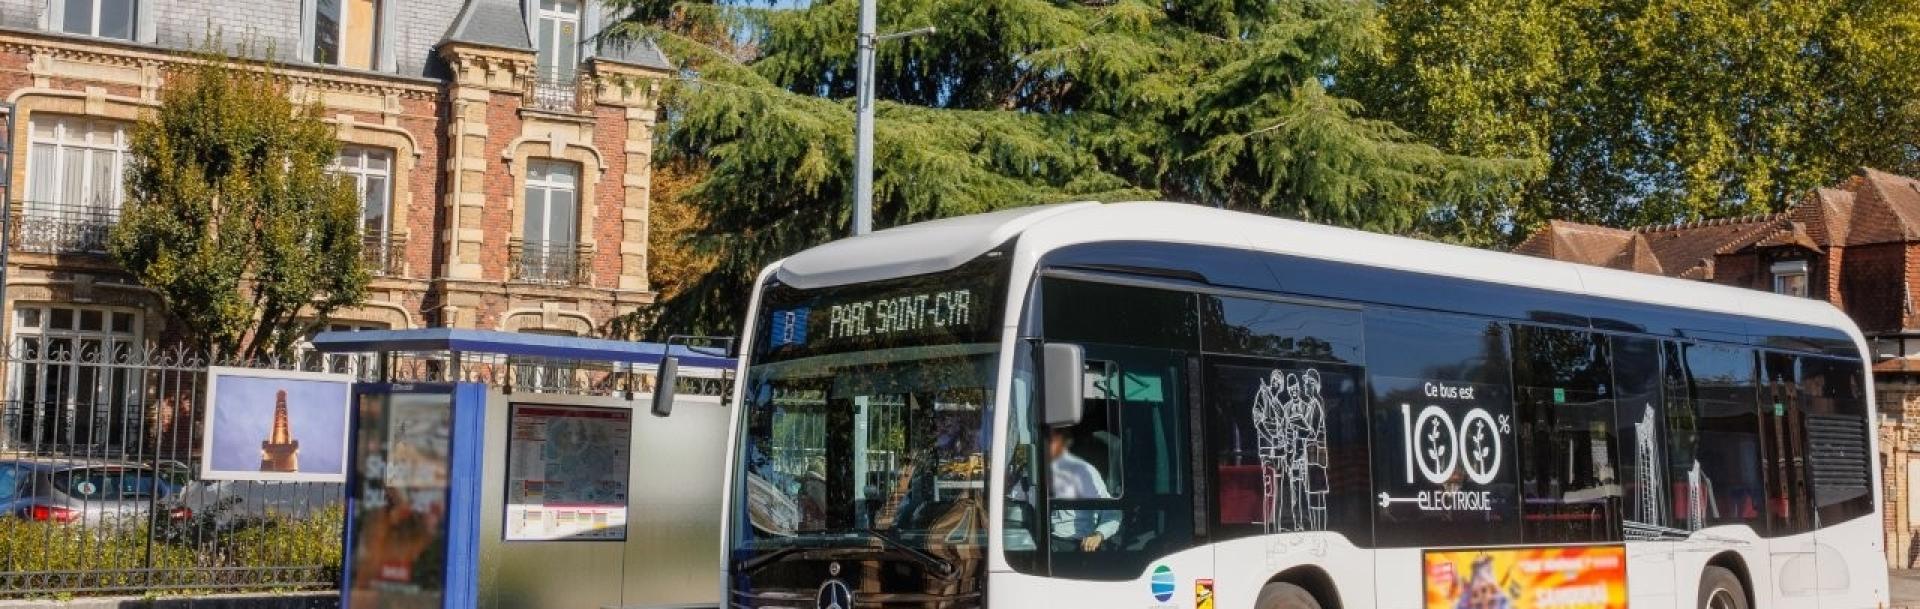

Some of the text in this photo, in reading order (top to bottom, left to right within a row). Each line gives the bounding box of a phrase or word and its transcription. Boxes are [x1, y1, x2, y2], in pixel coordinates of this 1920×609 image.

[829, 304, 873, 338] PARC
[876, 289, 970, 333] SAINT-CYR
[1424, 382, 1475, 400] Ce bus est
